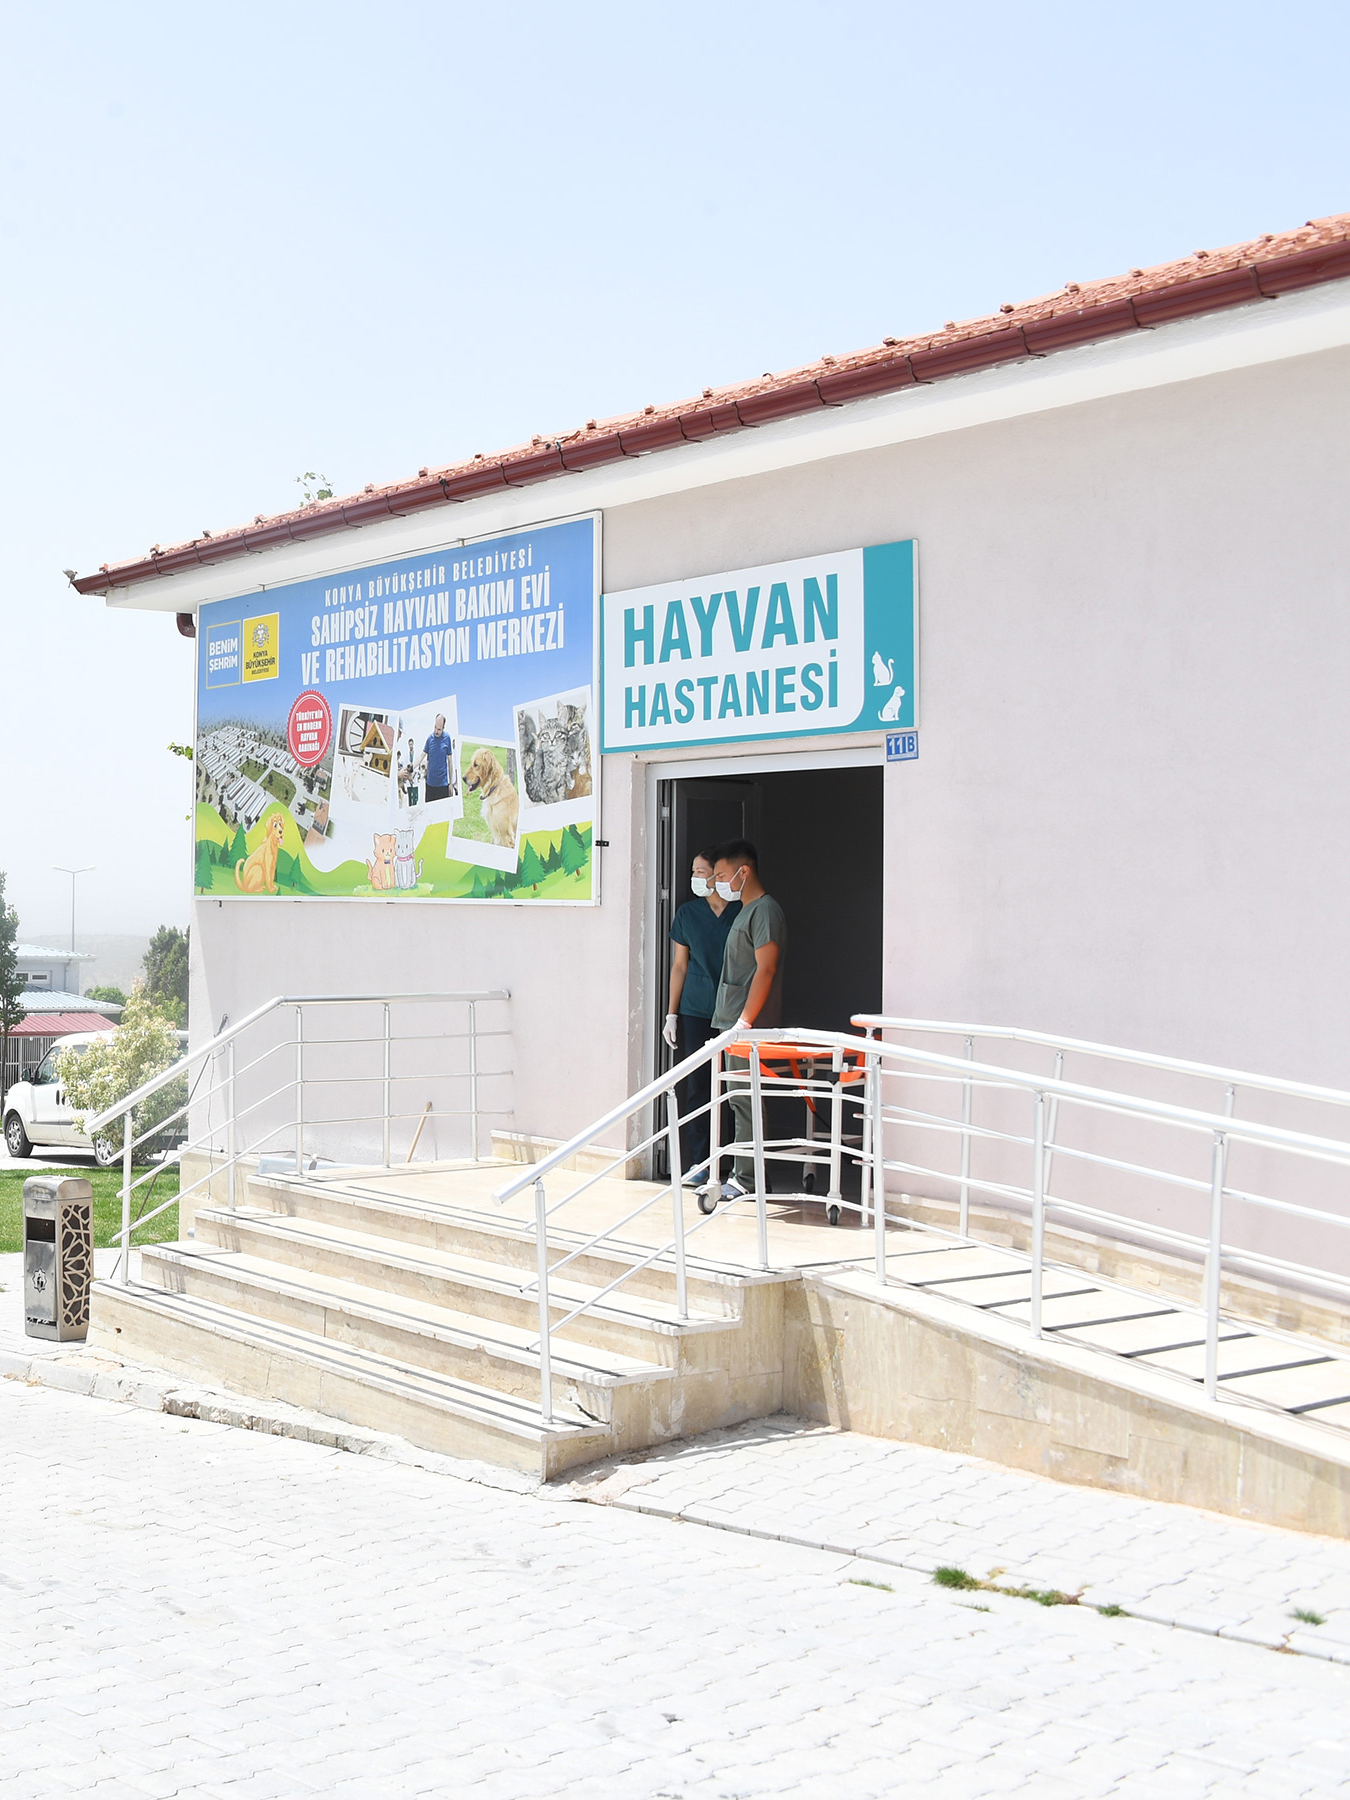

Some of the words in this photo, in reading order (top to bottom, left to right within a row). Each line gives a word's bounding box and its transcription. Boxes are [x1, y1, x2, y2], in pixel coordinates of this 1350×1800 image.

[311, 601, 378, 647] SAHİPSİZ
[383, 591, 449, 634] HAYVAN
[455, 579, 514, 622] BAKIM
[521, 565, 550, 610] EVİ
[325, 584, 361, 607] KONYA
[369, 564, 446, 599] BÜYÜKŞEHİR
[453, 544, 533, 582] BELEDİYESİ
[301, 651, 320, 686] VE
[325, 626, 470, 682] REHABİLİTASYON
[477, 603, 565, 660] MERKEZİ
[624, 573, 838, 668] HAYVAN
[624, 649, 838, 729] HASTANESİ
